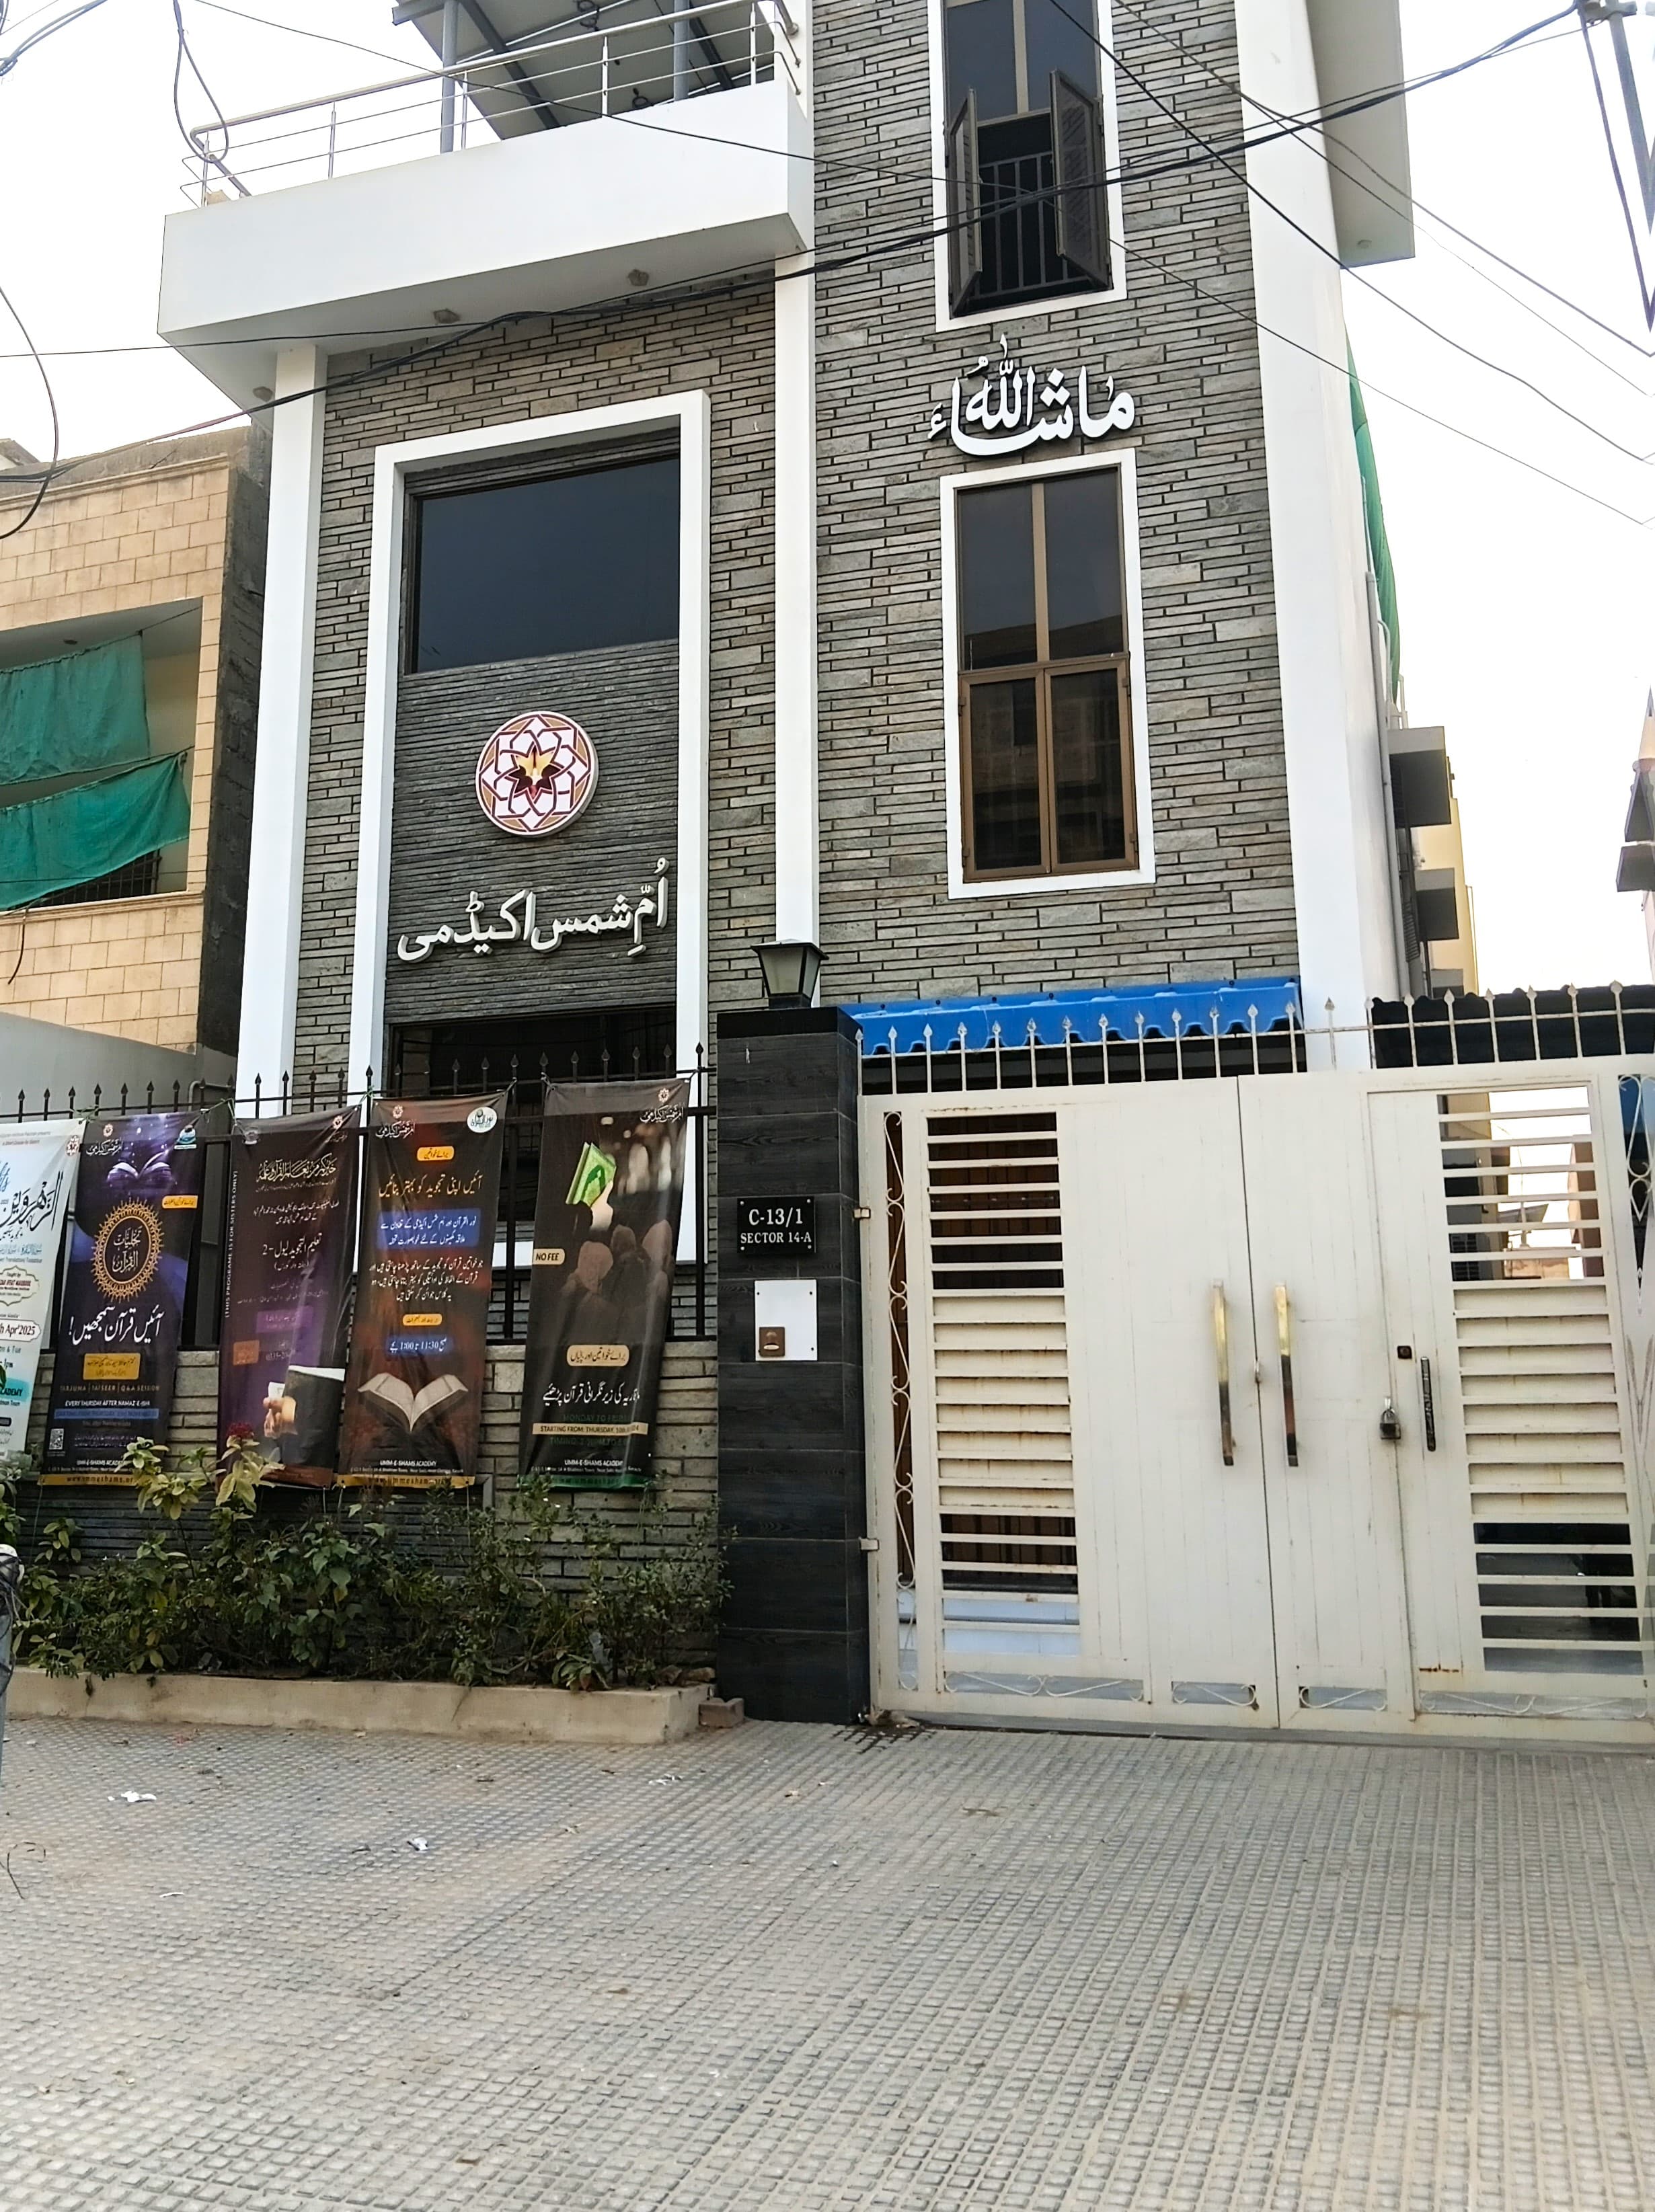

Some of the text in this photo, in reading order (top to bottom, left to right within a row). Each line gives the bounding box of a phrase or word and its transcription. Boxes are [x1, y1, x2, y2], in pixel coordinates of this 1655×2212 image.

[397, 890, 537, 963] اکیڈمی
[530, 894, 633, 953] شمس
[417, 1173, 428, 1194] کو
[748, 1207, 804, 1228] C-13/1
[740, 1231, 812, 1244] SECTOR 14-A
[535, 1253, 560, 1261] NO FEE
[104, 1308, 137, 1342] قرآن
[564, 1382, 584, 1404] قرآن
